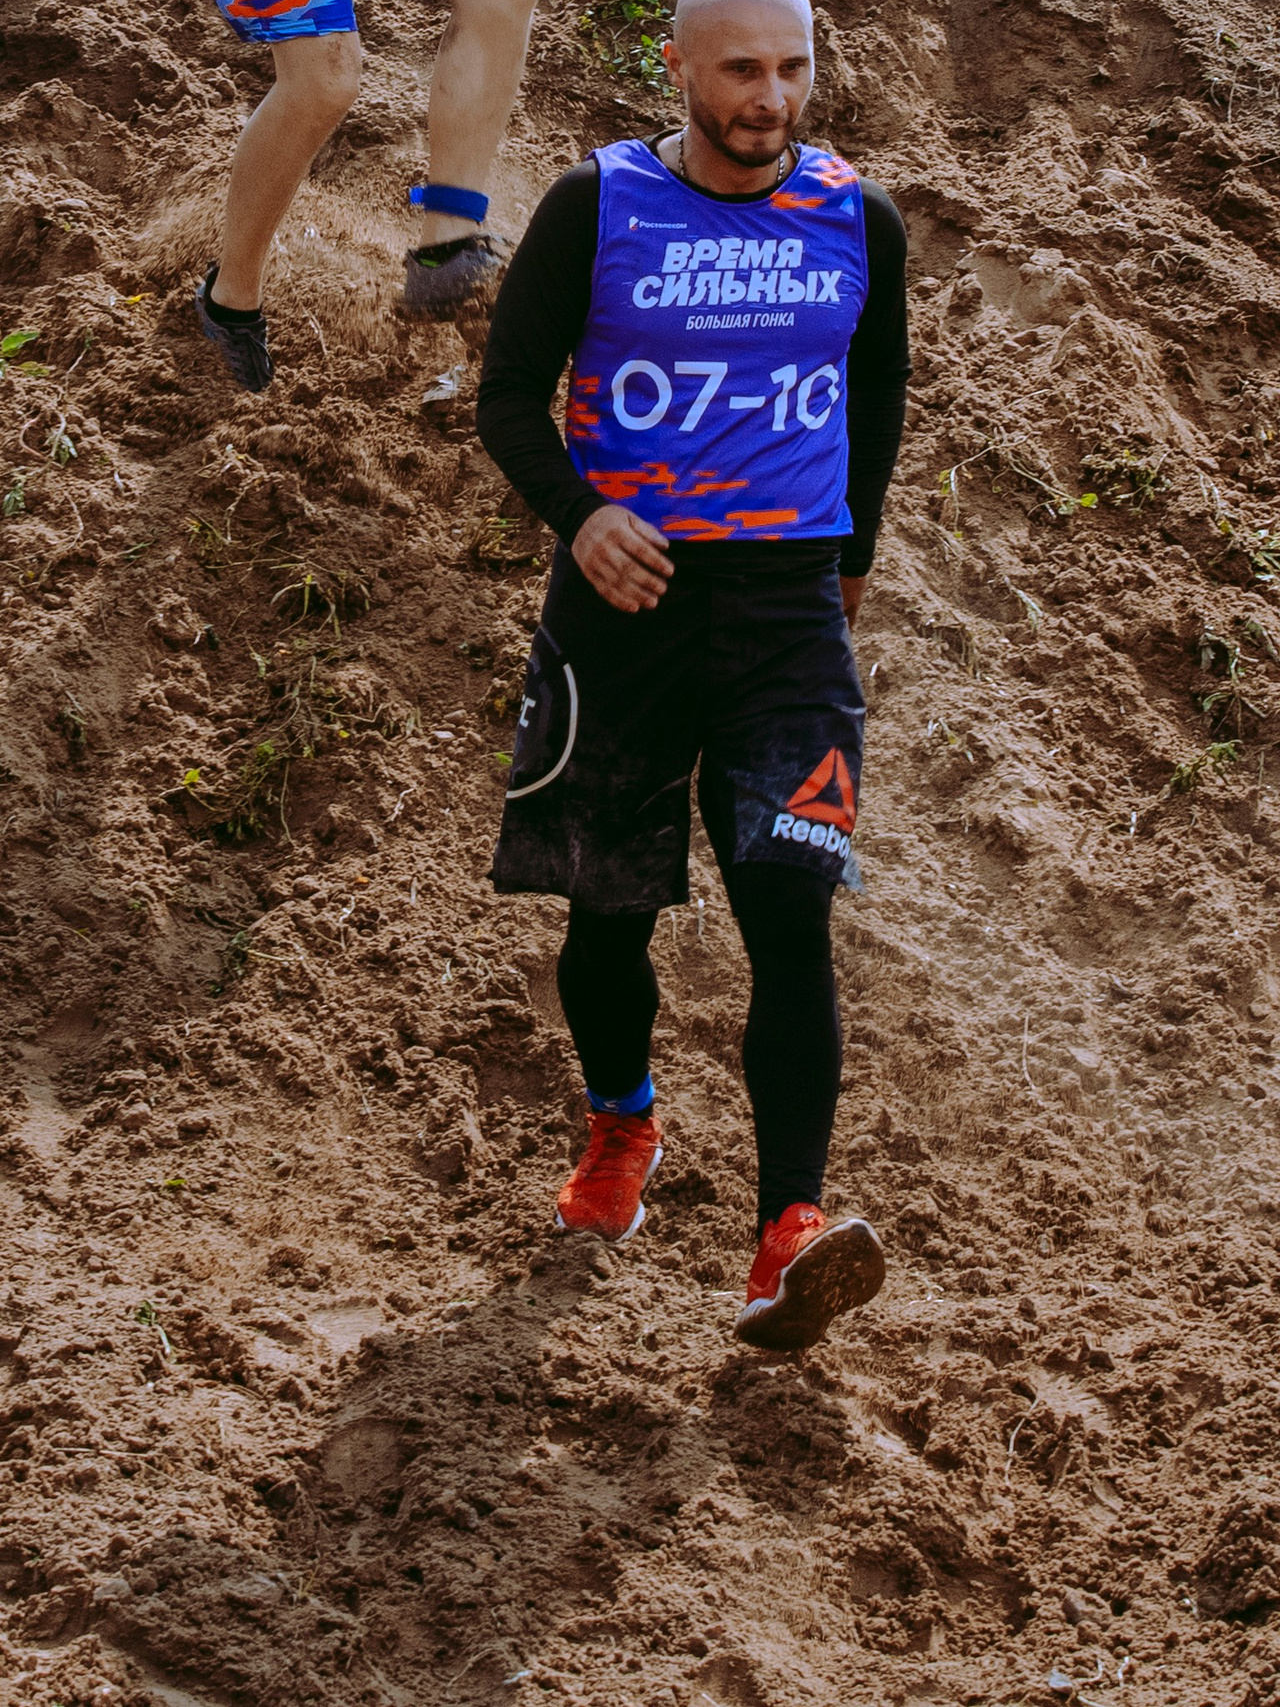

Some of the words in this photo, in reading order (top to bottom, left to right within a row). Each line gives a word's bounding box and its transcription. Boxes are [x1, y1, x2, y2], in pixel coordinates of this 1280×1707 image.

[661, 238, 803, 273] ВРЕМЯ
[632, 269, 842, 309] СИЛЬНЫХ
[686, 314, 751, 330] БОЛЬШАЯ
[752, 312, 795, 328] ГОНКА
[611, 359, 840, 432] 07-10
[771, 813, 850, 861] Reebo
